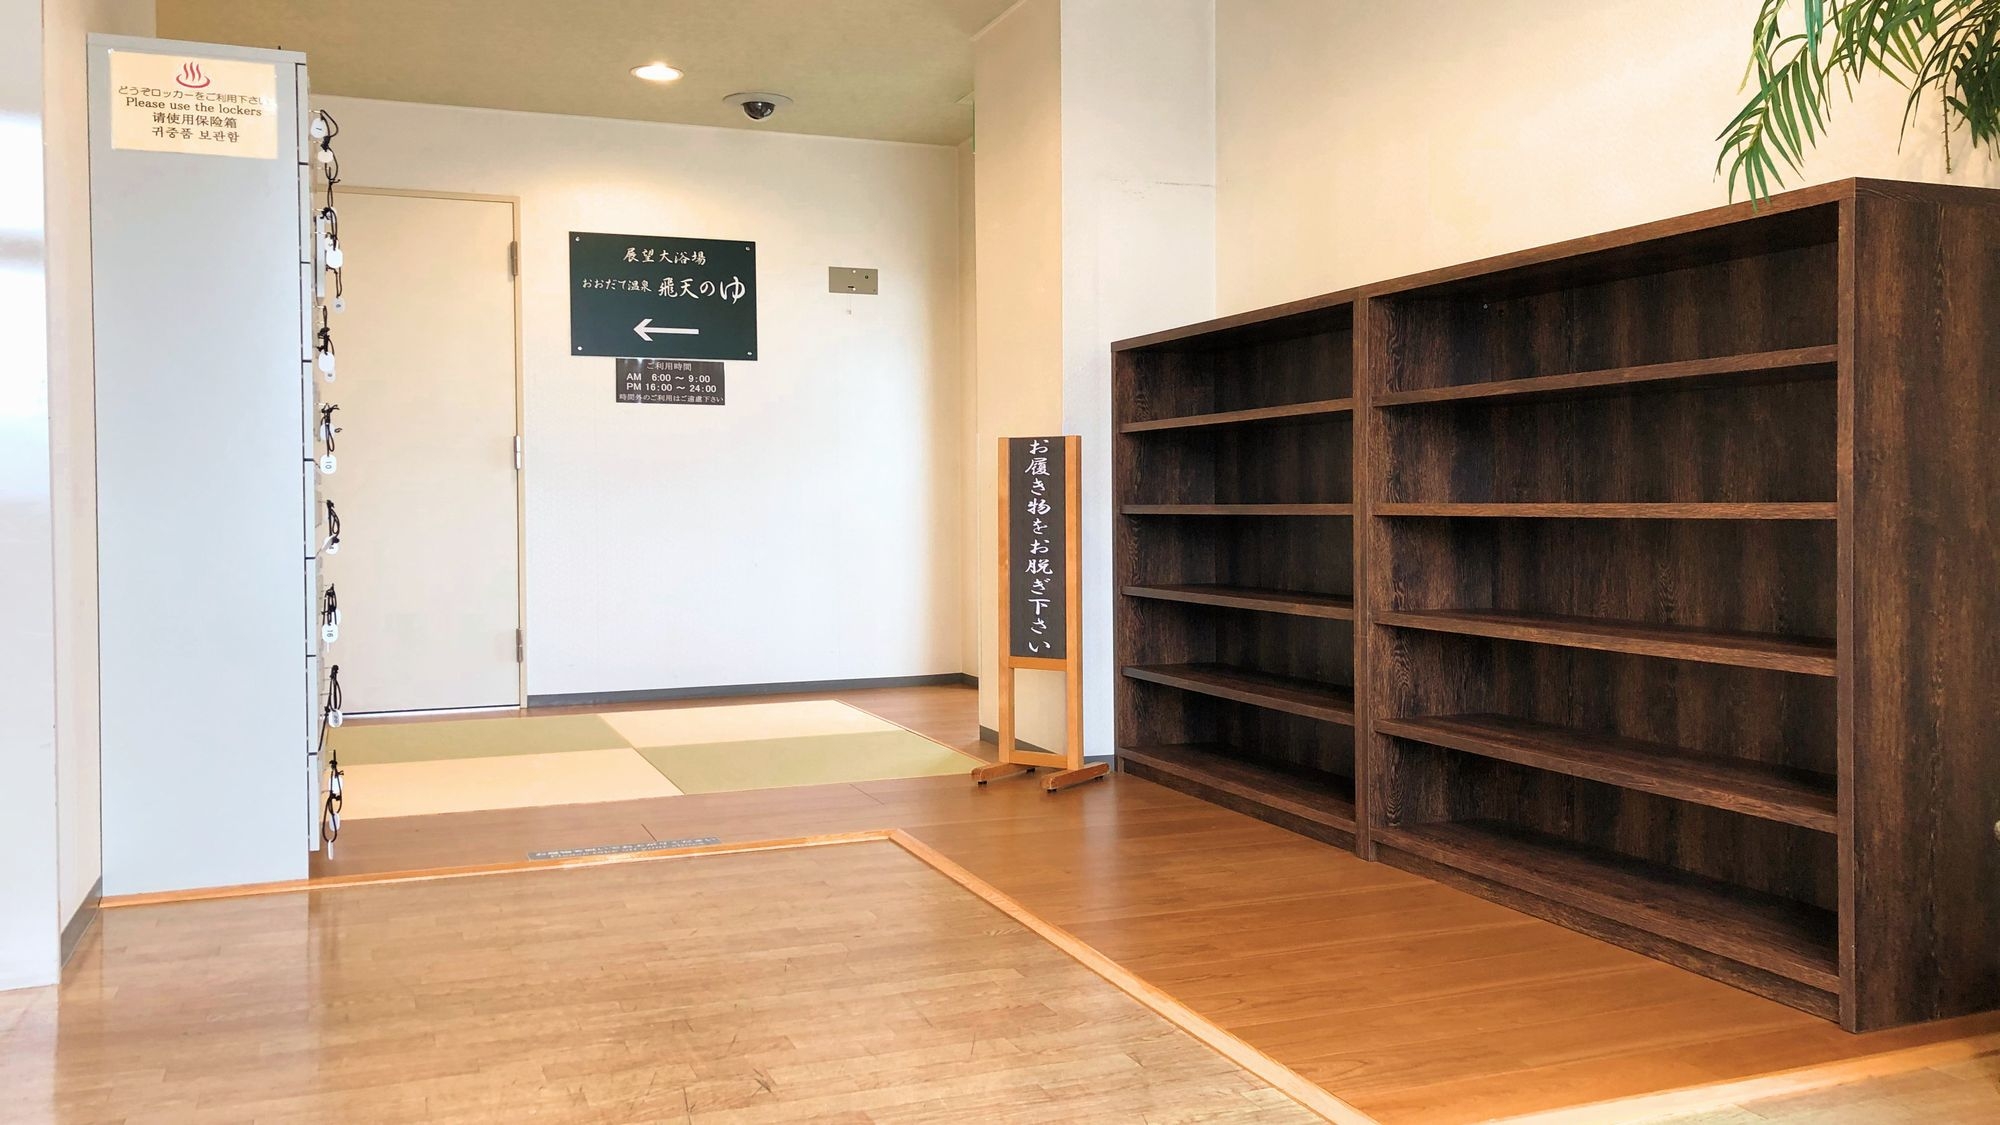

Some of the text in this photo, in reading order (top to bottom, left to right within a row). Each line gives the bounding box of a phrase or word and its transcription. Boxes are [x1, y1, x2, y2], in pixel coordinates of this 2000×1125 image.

[126, 97, 262, 117] Please use the lockers
[152, 112, 237, 129] 请使用保险箱
[152, 126, 240, 143] 귀중품 보관함
[623, 246, 706, 266] 展望大浴場
[582, 275, 746, 304] おおだて温泉 飛天のゆ
[646, 362, 692, 372] ご利用時間
[626, 372, 642, 381] AM
[651, 373, 672, 382] 6:00
[688, 374, 711, 383] 9:00
[626, 382, 642, 391] PM
[645, 383, 673, 392] 16:00
[689, 384, 717, 393] 24:00
[1024, 439, 1053, 653] お履き物をお脱ぎ下さい
